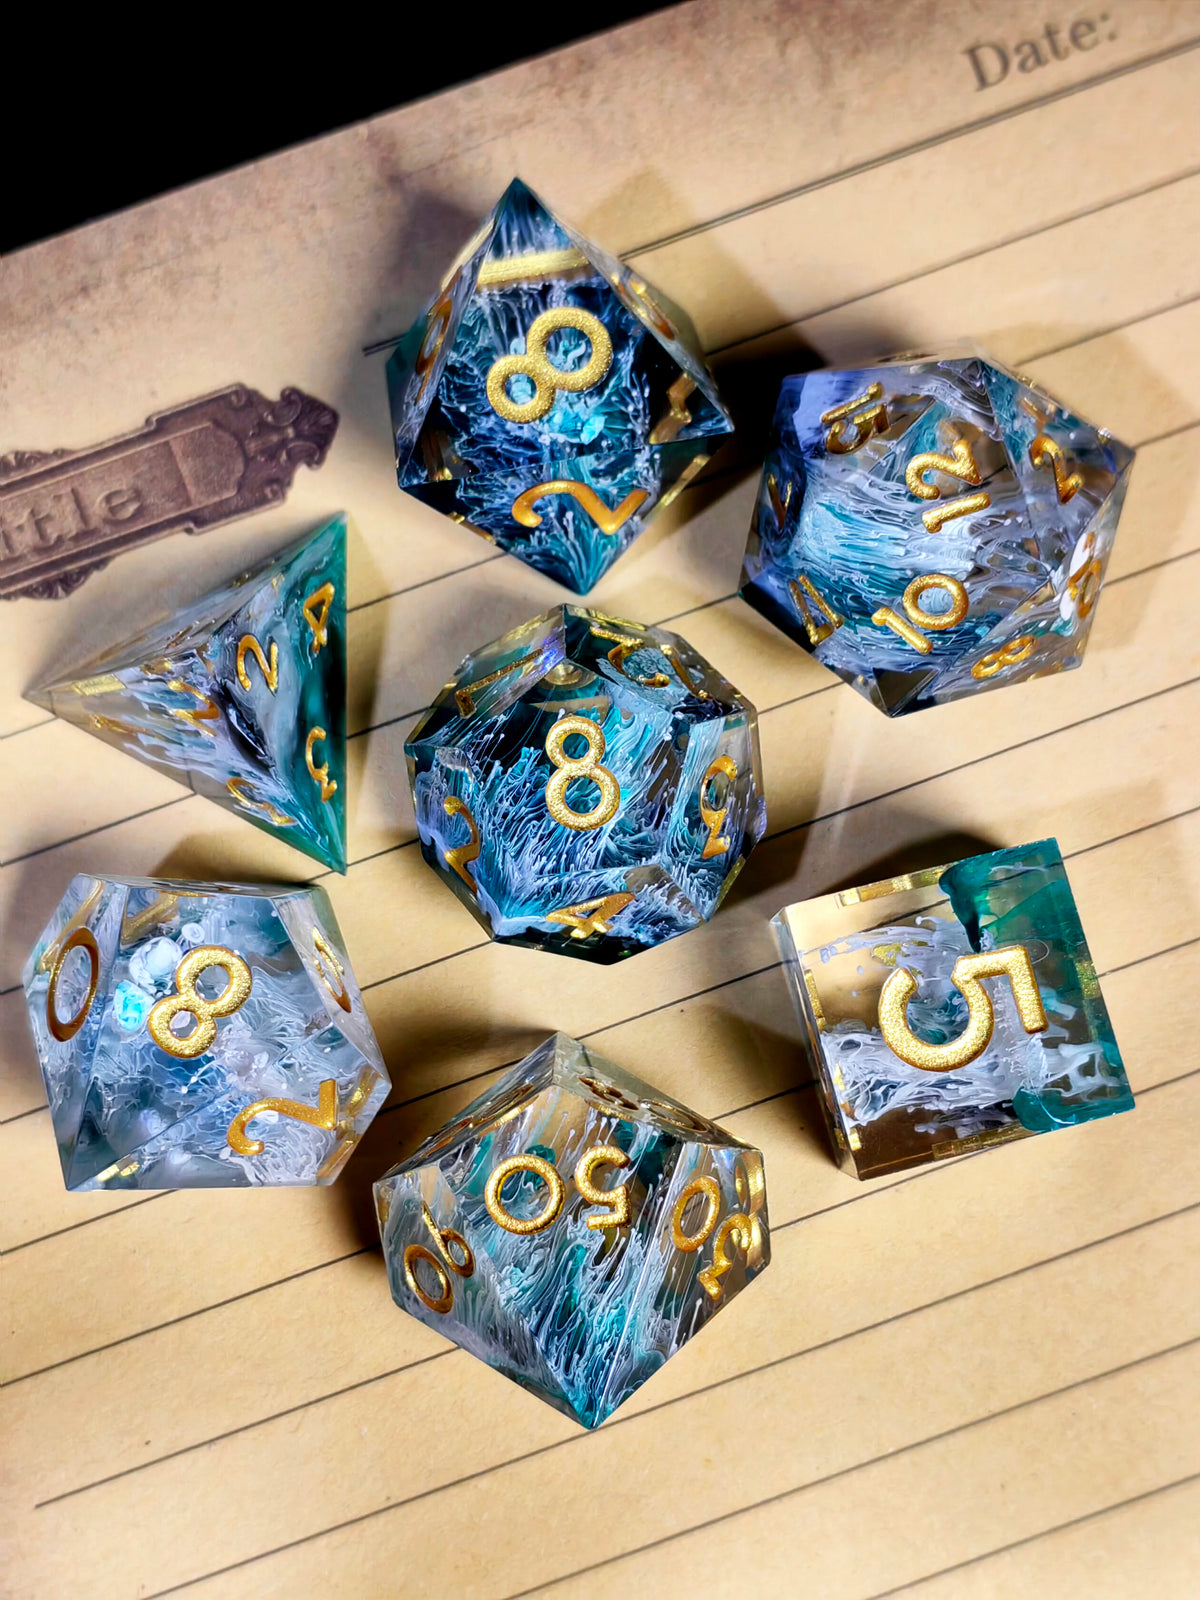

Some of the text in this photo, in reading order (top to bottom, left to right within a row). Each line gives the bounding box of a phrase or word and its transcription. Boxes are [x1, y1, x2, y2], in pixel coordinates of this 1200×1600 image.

[961, 13, 1118, 92] Date:
[487, 307, 612, 423] 8
[822, 381, 890, 456] 15
[511, 480, 649, 535] 2
[905, 439, 991, 534] 12
[1031, 434, 1085, 505] 2
[872, 573, 970, 655] 10
[971, 634, 1040, 681] 8
[545, 715, 620, 832] 8
[47, 926, 99, 1042] 0
[148, 945, 252, 1059] 8
[878, 945, 1049, 1073] 5
[227, 1078, 337, 1156] 2
[484, 1145, 632, 1236] 50
